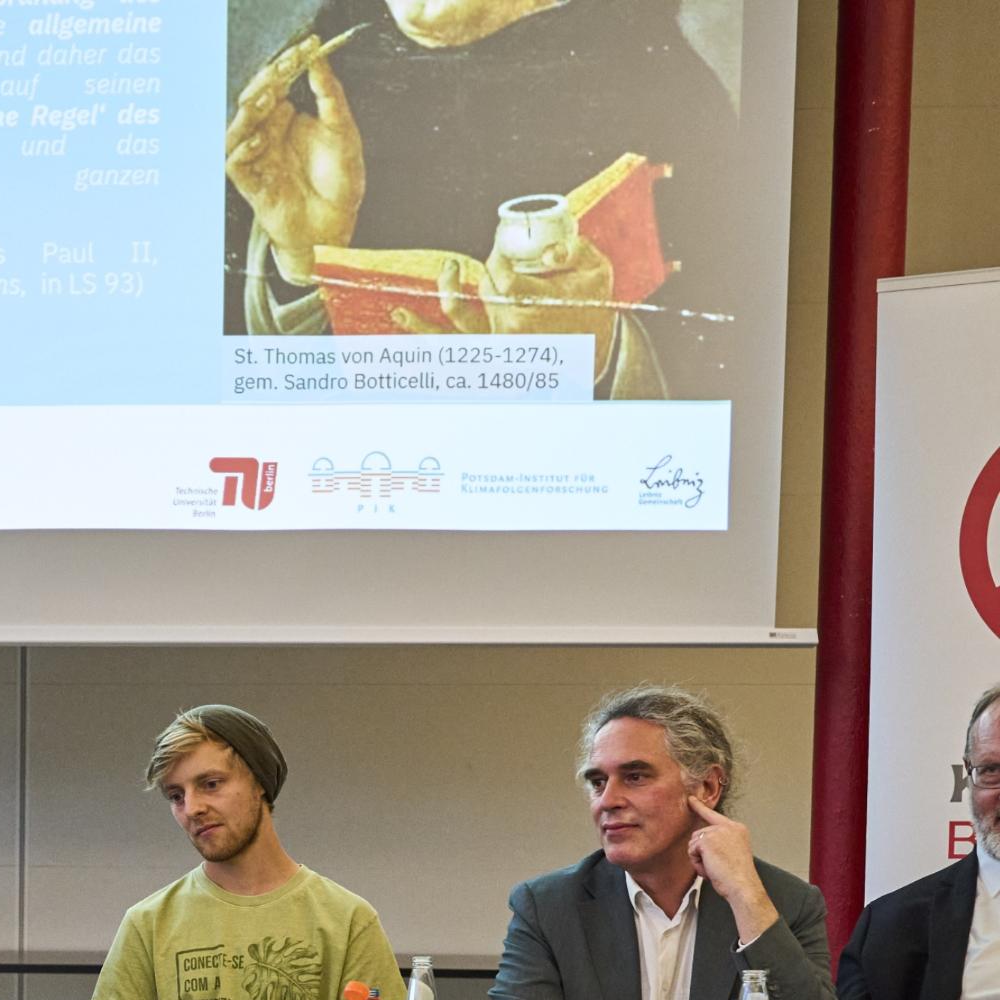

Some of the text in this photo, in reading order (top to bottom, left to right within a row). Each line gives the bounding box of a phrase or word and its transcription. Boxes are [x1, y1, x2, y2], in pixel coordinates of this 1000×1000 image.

[29, 12, 162, 40] allgemeine
[38, 43, 107, 66] daher
[118, 43, 160, 64] das
[1, 73, 40, 100] auf
[85, 74, 161, 94] seinen
[118, 103, 160, 124] des
[22, 134, 66, 156] und
[116, 134, 159, 155] das
[74, 168, 159, 192] ganzen
[43, 242, 94, 264] Paul
[41, 273, 62, 294] in
[70, 272, 96, 295] LS
[105, 272, 143, 297] 93)
[235, 347, 563, 367] St. Thomas von Aquin (1225-1274),
[234, 372, 559, 394] gem. Sandro Botticelli, ca. 1480/85
[184, 976, 221, 993] COM A
